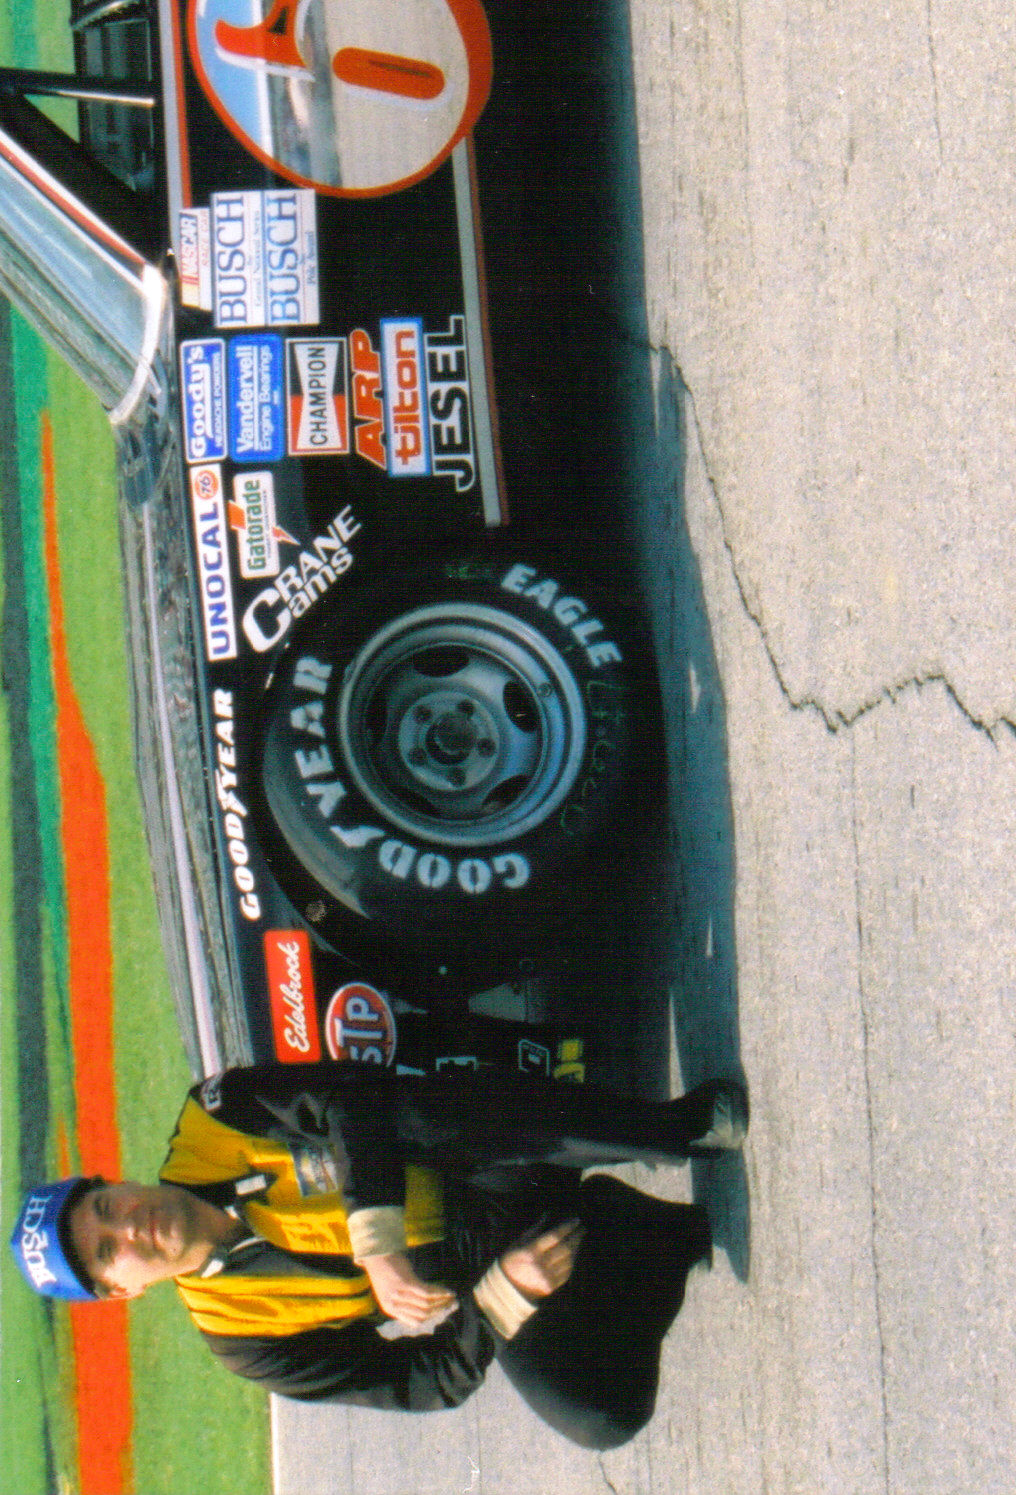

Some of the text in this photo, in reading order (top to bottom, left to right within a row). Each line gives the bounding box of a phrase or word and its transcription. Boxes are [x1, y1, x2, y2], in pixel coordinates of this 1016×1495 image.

[178, 213, 198, 277] NASCAR
[215, 194, 248, 326] BUSCH
[265, 193, 301, 324] BUSCH
[187, 345, 214, 458] Goody's
[235, 345, 254, 454] Vandervell
[257, 344, 275, 451] Engine Bearings
[307, 346, 329, 446] CHAMPION
[348, 328, 388, 471] ARP
[392, 329, 422, 465] tilton
[423, 314, 476, 493] JESEL
[199, 501, 232, 655] UNOCAL
[241, 479, 266, 571] Gatorade
[242, 504, 362, 652] CRANE
[501, 562, 623, 668] EAGLE
[212, 687, 262, 921] GOODYEAR
[290, 655, 532, 894] GOODYEAR
[276, 940, 312, 1053] Edelbrock
[333, 996, 383, 1064] STP
[21, 1194, 58, 1289] BUSCH
